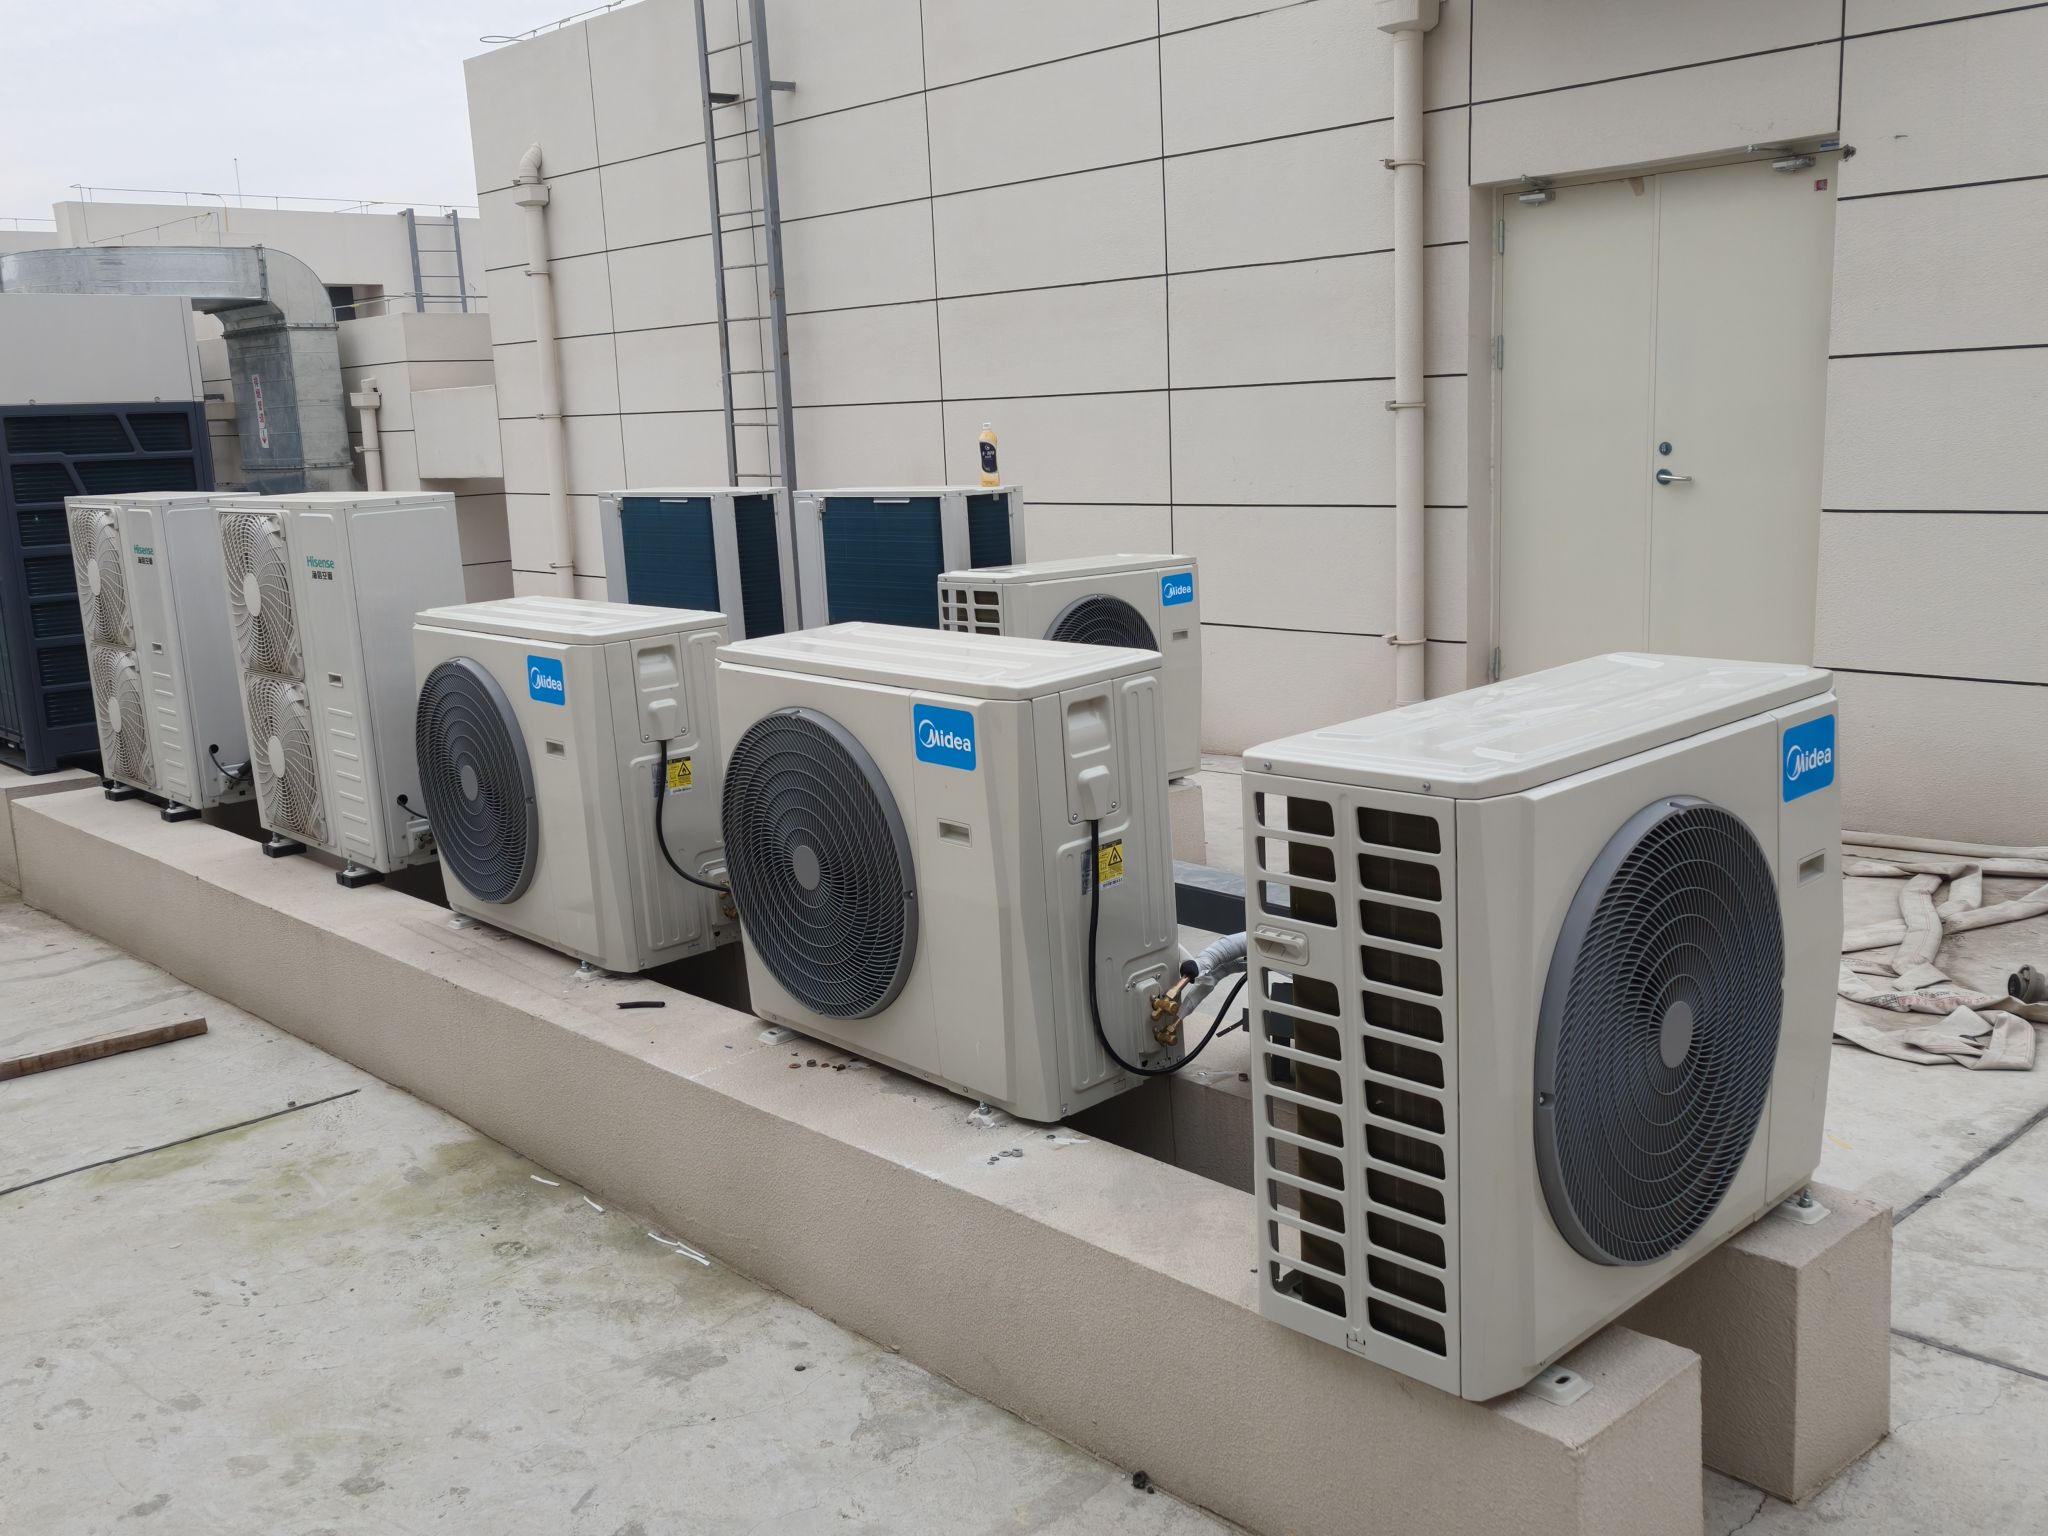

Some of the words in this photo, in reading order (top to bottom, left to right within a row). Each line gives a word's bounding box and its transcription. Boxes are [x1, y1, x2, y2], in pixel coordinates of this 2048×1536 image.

[306, 555, 335, 569] Hisense
[1164, 583, 1192, 599] Midea
[530, 666, 563, 692] Midea
[918, 719, 972, 752] Midea
[1786, 745, 1832, 781] Midea
